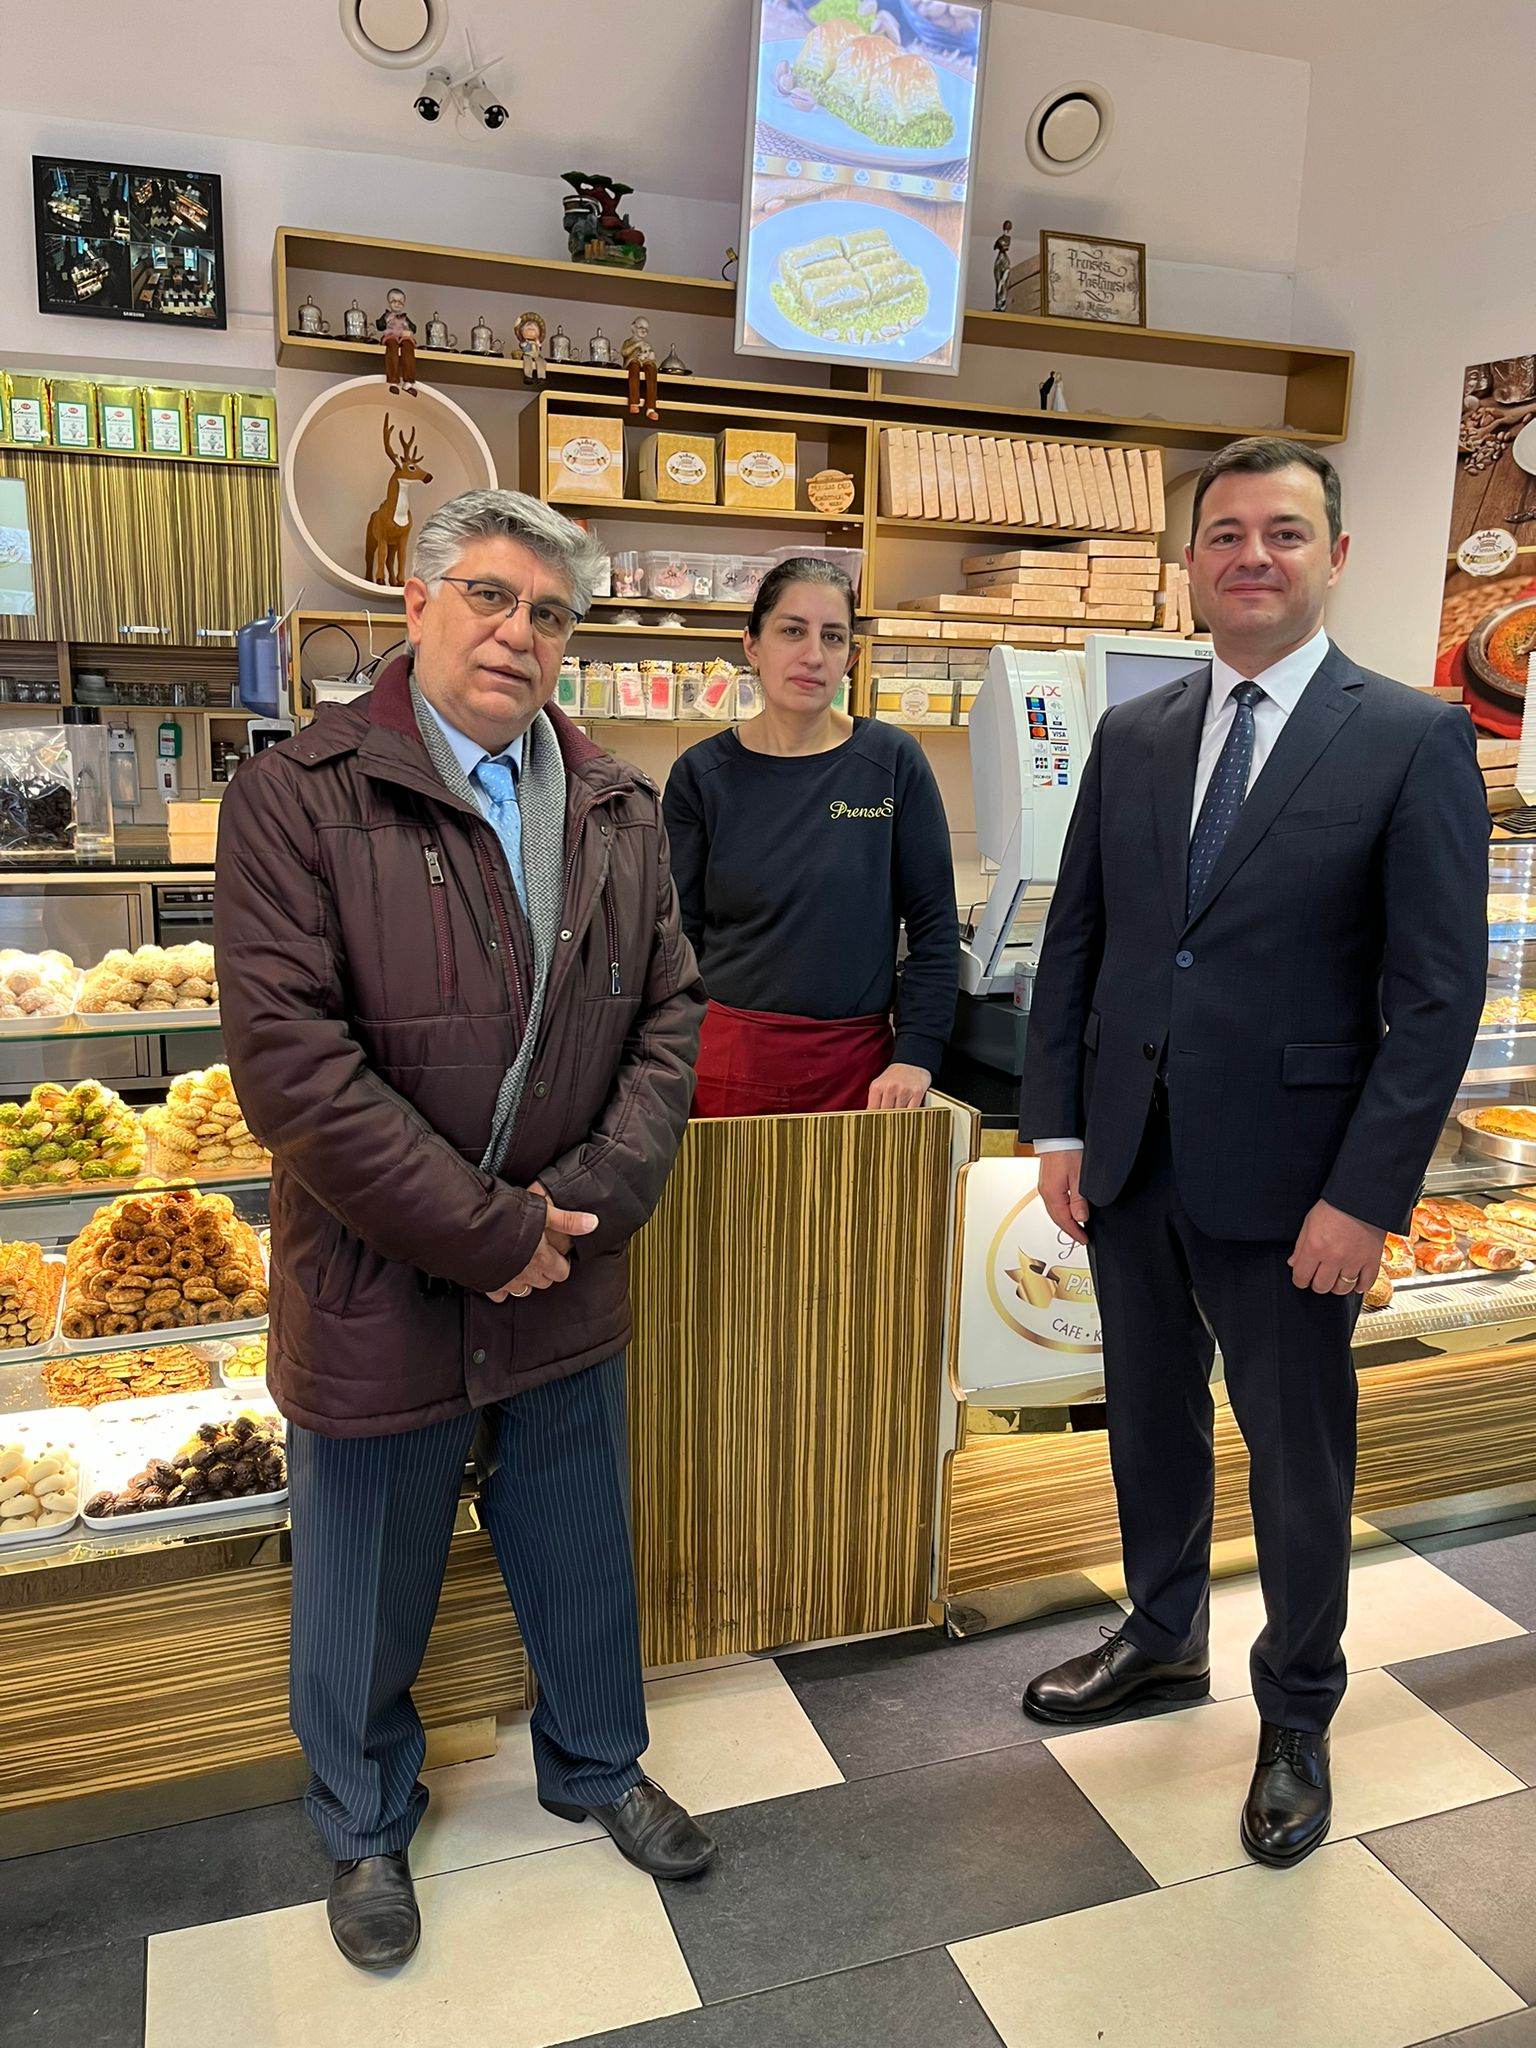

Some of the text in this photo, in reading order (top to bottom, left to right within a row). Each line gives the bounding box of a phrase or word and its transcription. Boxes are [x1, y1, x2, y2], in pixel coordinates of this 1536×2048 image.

[1026, 685, 1061, 697] SIX
[1065, 1273, 1097, 1296] PA
[1052, 1318, 1083, 1340] CAFE
